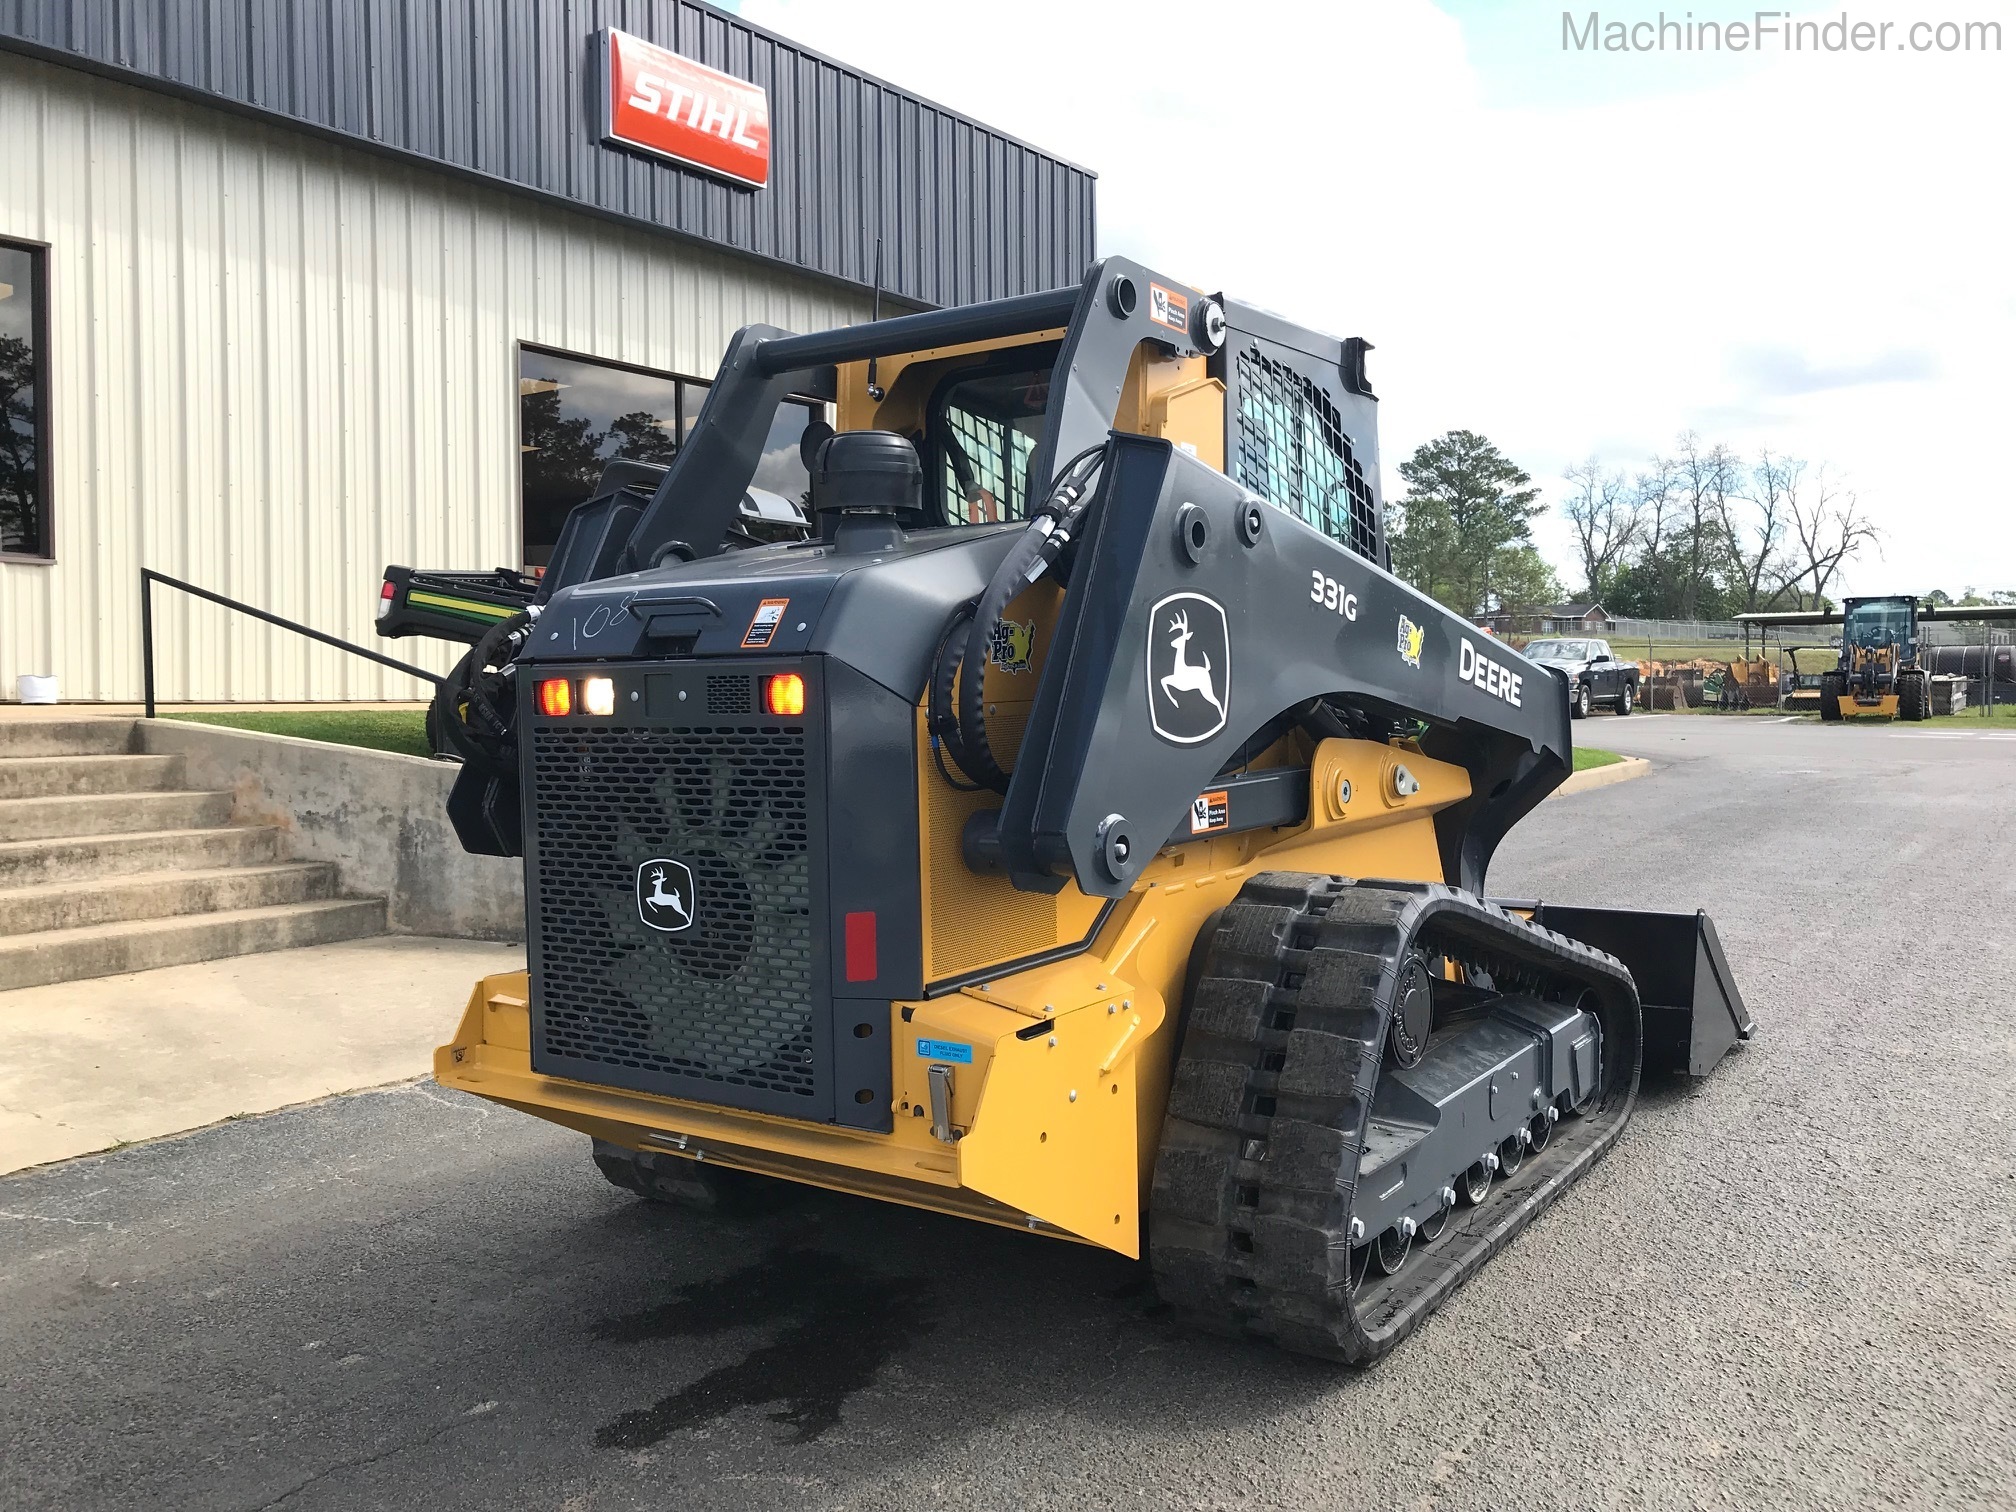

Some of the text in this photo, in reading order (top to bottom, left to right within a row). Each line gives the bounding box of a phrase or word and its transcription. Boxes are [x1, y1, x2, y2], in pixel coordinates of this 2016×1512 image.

[628, 71, 759, 150] STIHL
[1310, 570, 1357, 622] 331G
[1459, 637, 1523, 707] DEERE
